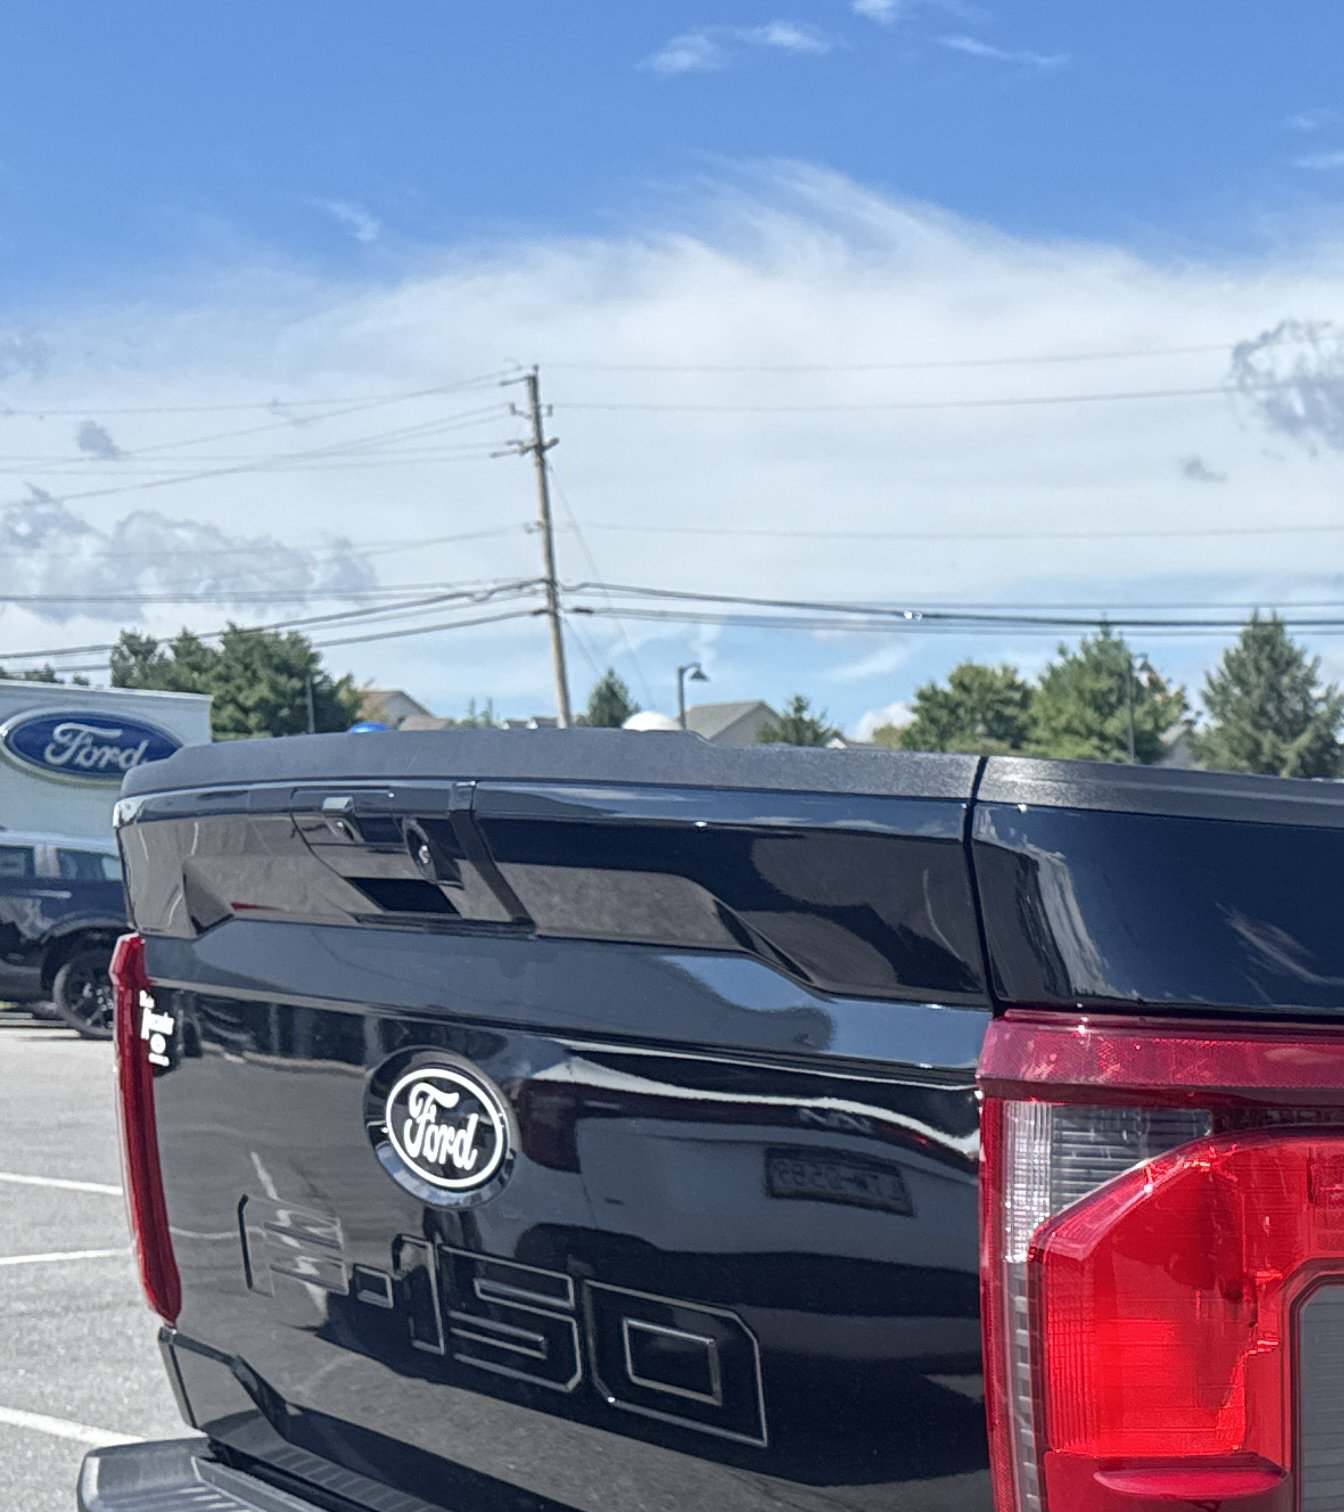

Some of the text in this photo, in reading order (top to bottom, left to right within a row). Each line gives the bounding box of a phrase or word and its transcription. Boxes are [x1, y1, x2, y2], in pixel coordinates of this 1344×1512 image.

[43, 721, 150, 771] Ford
[403, 1082, 479, 1171] Ford
[238, 1193, 771, 1450] F-150
